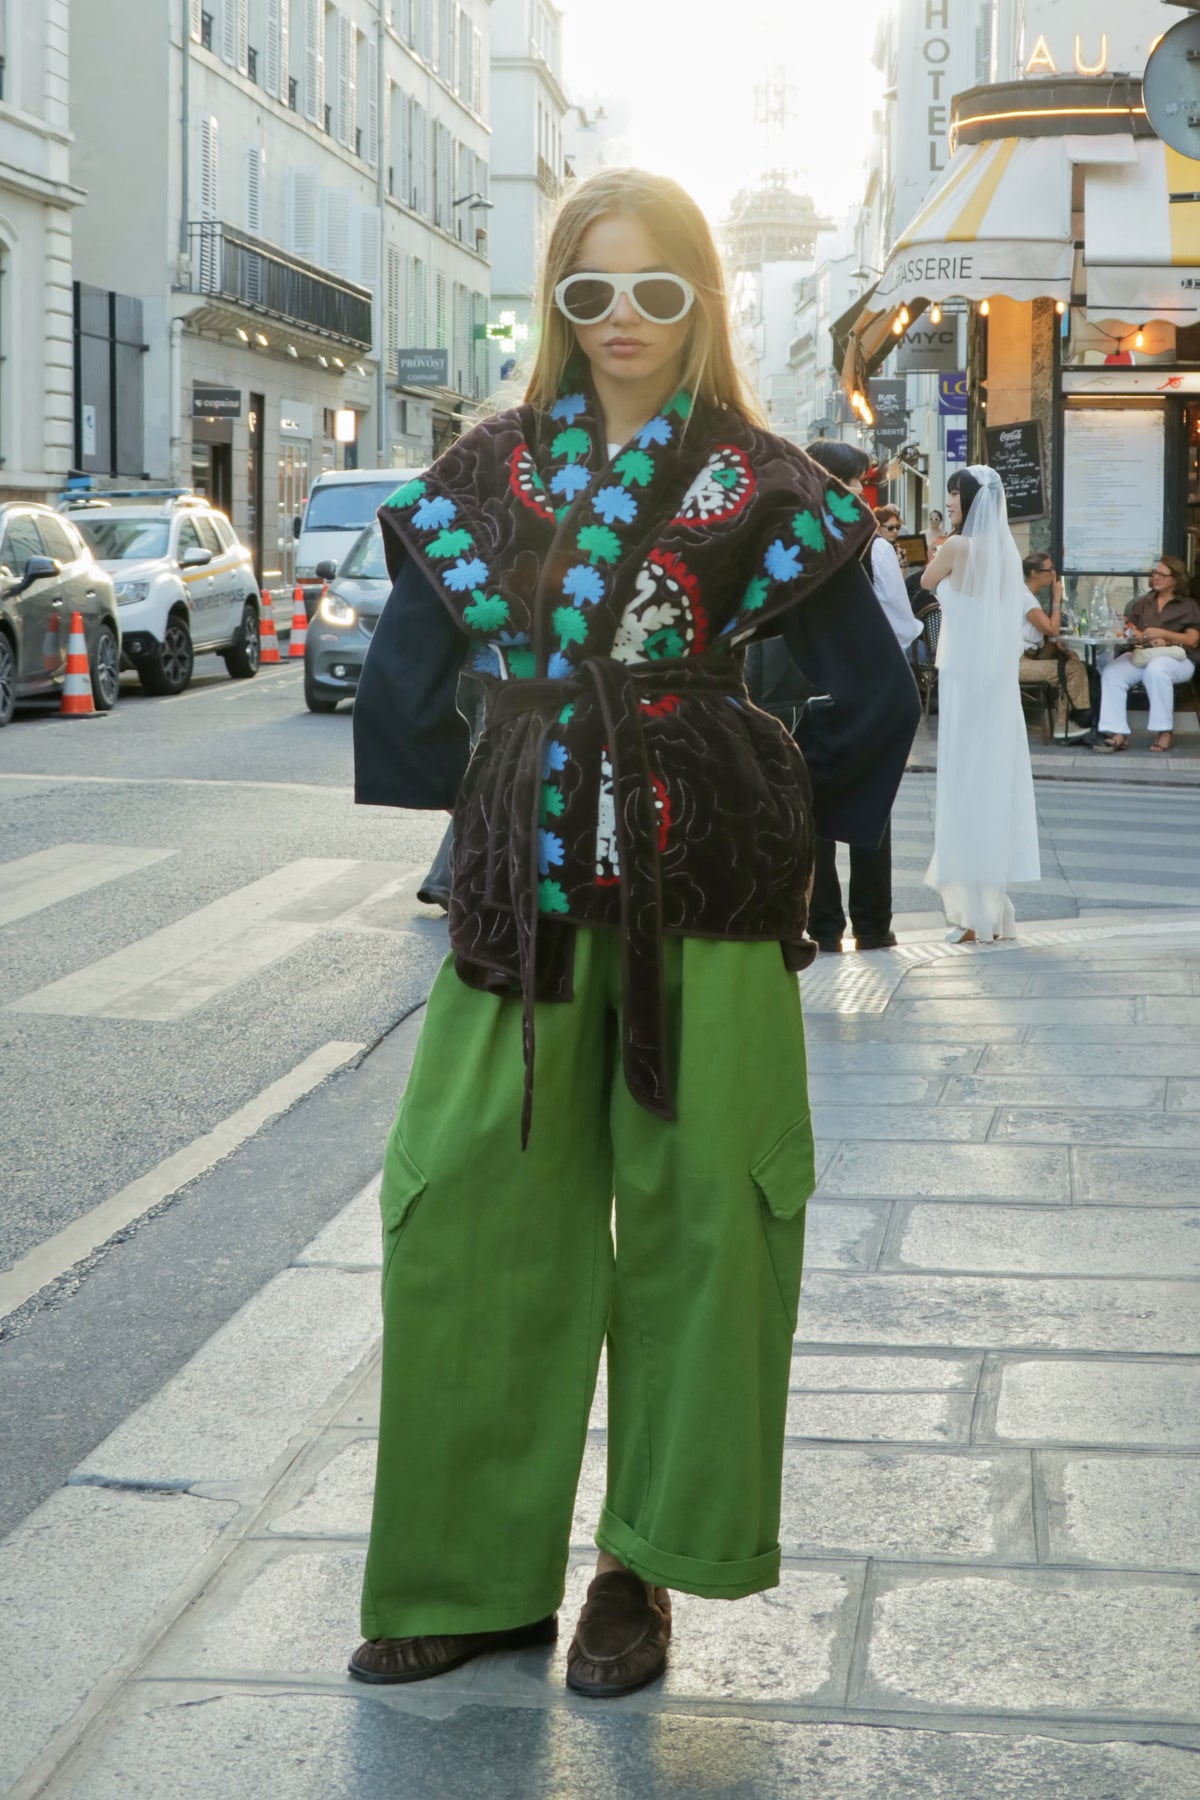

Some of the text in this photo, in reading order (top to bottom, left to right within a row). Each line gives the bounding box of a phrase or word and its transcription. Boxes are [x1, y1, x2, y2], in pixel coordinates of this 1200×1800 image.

[1025, 33, 1109, 75] AU
[923, 0, 950, 172] HOTEL
[903, 331, 954, 344] MYC
[401, 359, 446, 368] PROVOST
